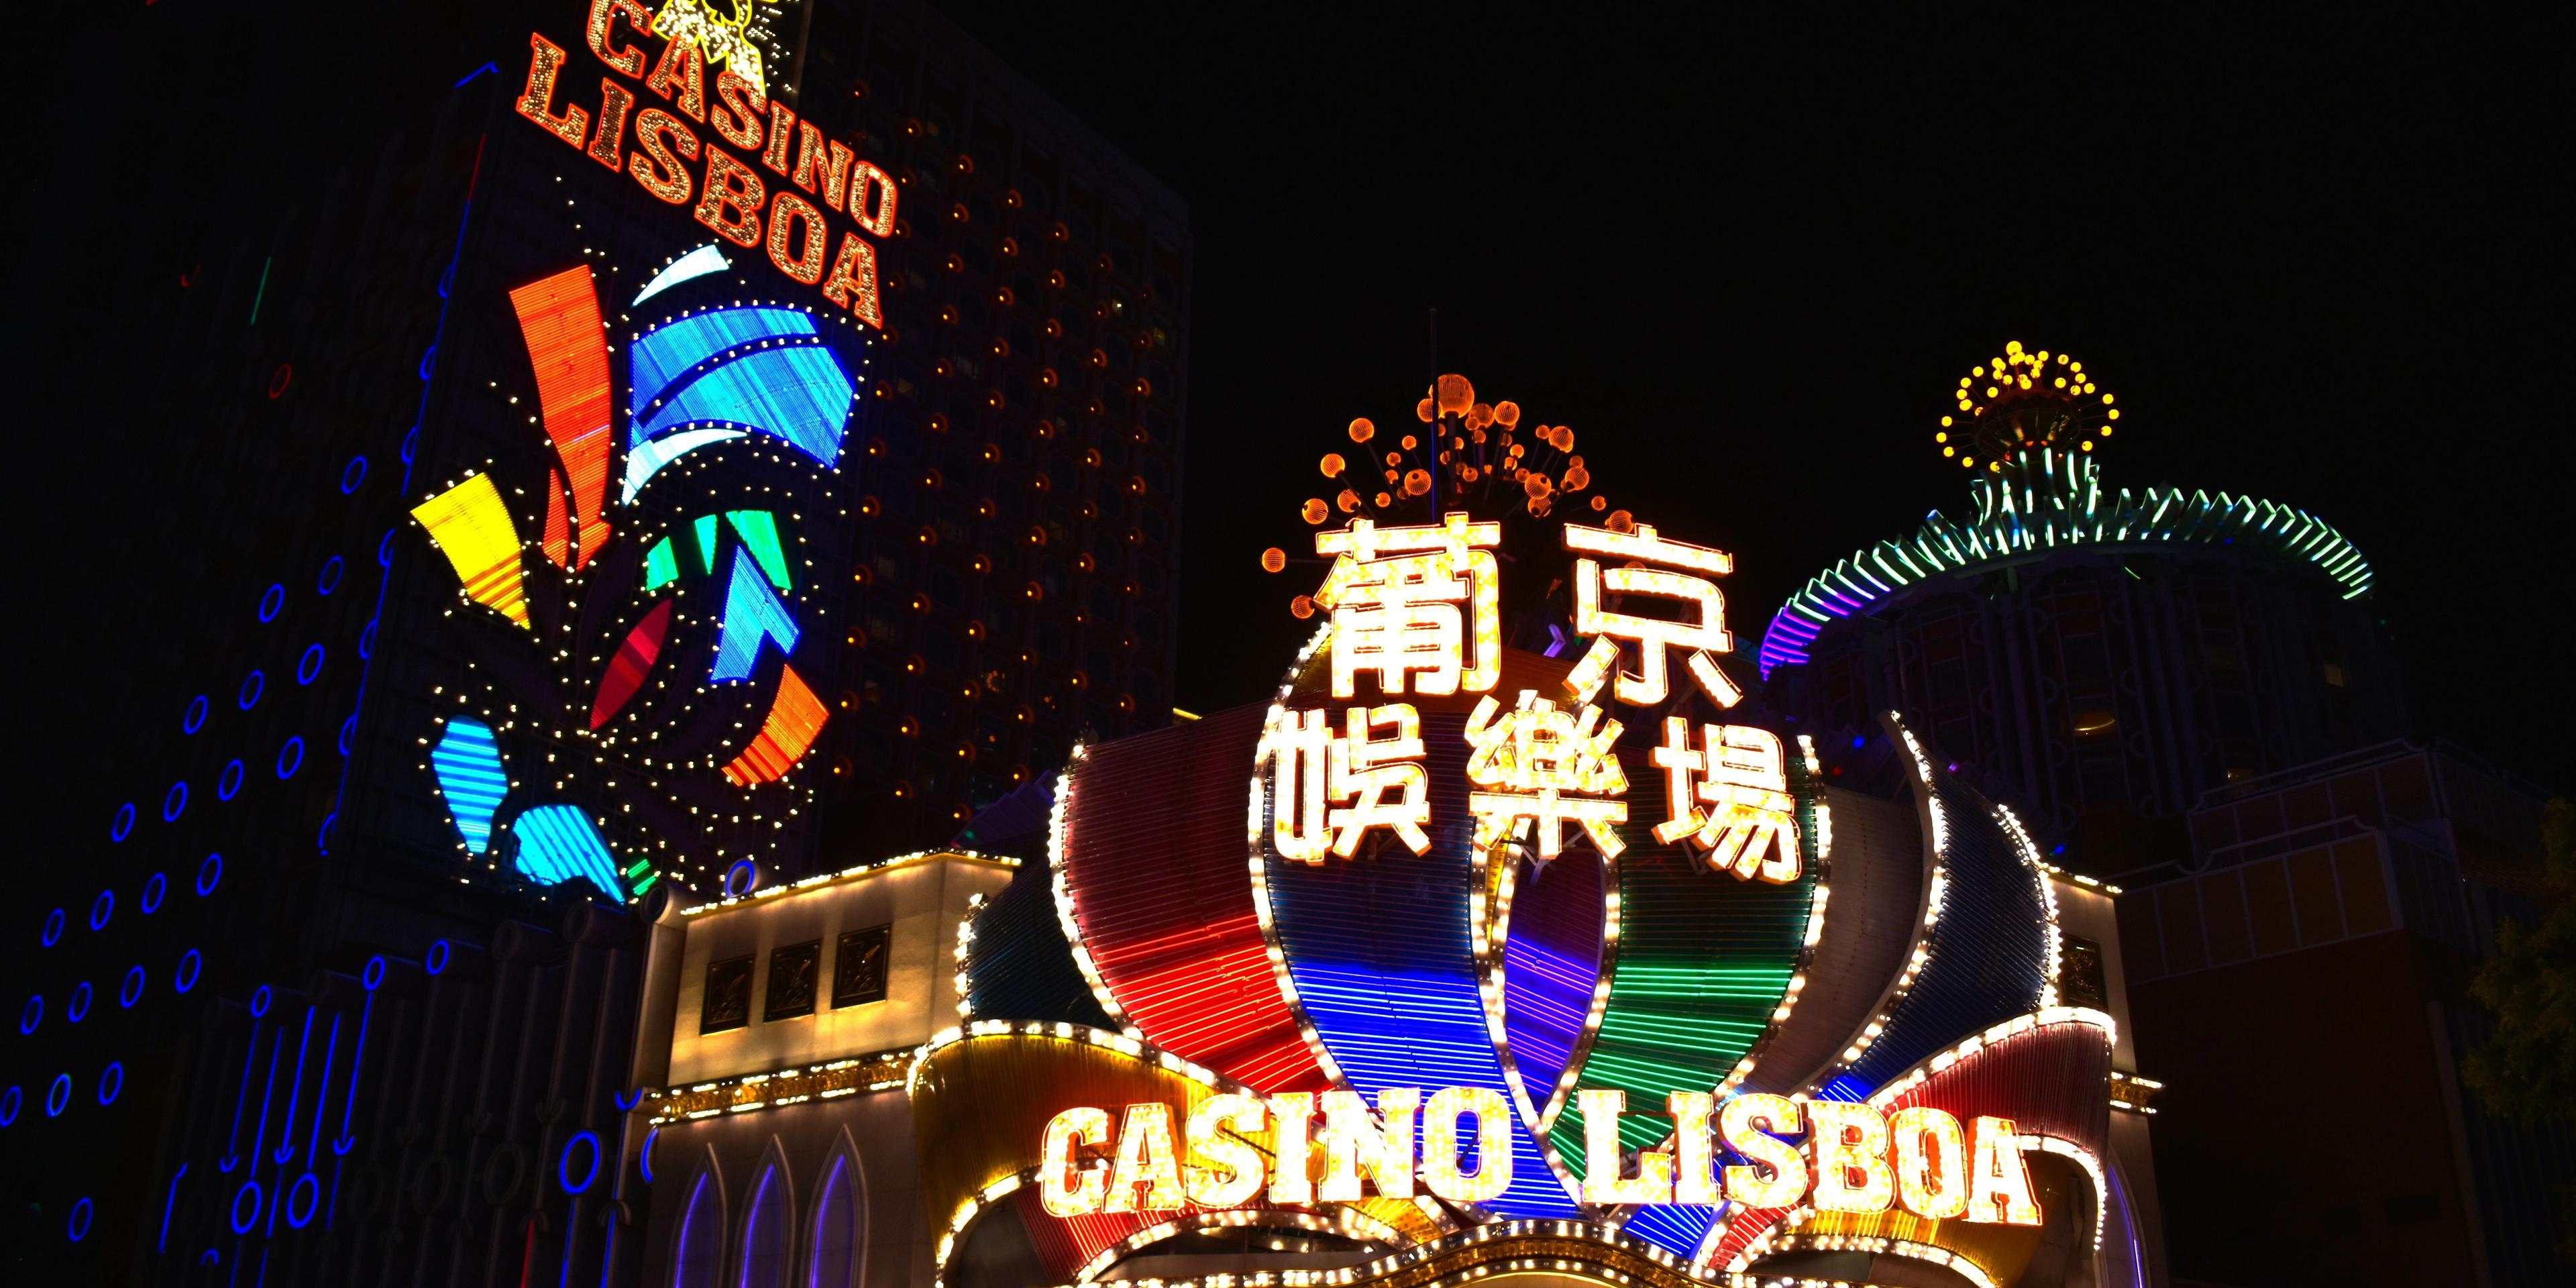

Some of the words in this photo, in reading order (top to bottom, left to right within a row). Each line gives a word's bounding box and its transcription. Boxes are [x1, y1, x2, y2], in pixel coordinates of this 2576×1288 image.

[516, 32, 883, 329] LISBOA
[586, 0, 898, 237] CASINO
[1313, 512, 1743, 710] 葡京
[1274, 689, 1802, 884] 娛樂場
[1040, 1087, 1513, 1218] CASINO
[1577, 1089, 2044, 1226] LISBOA
